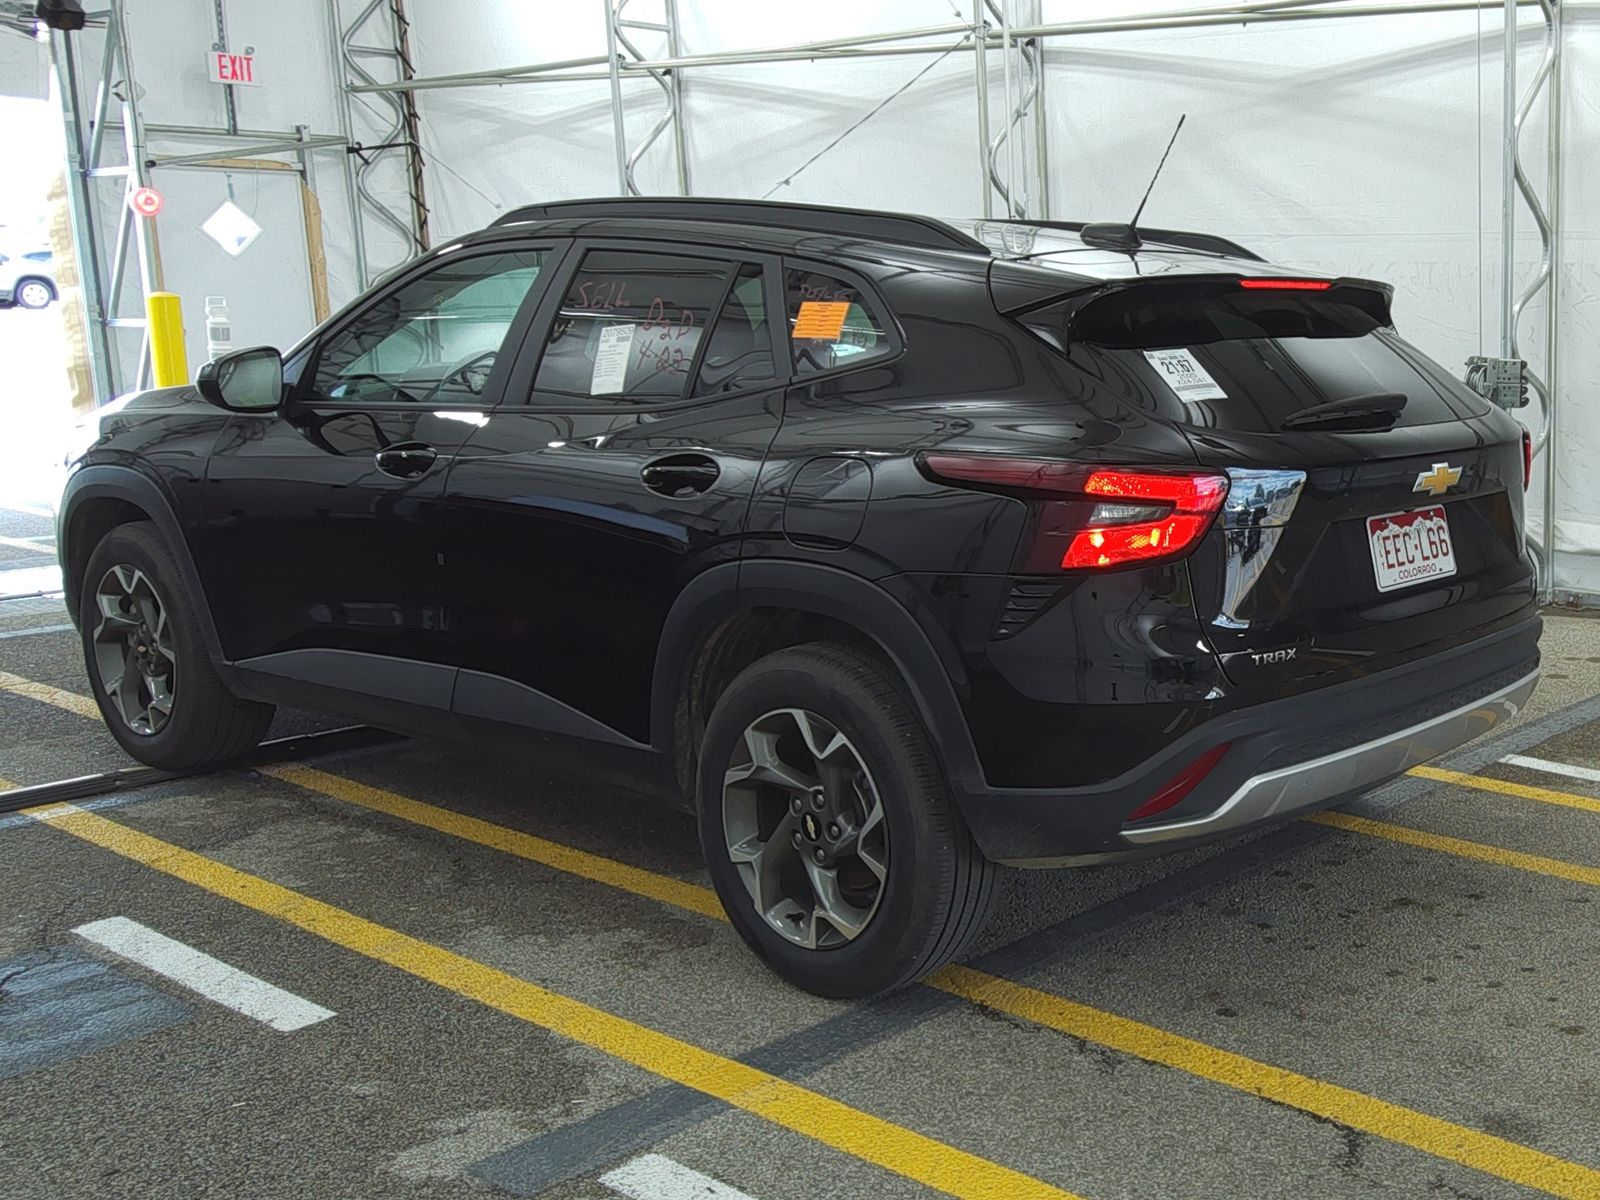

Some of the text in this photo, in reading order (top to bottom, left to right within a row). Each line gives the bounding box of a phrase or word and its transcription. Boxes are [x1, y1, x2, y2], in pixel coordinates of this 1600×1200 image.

[217, 53, 252, 82] EXIT
[1398, 563, 1437, 580] COLORADO
[1251, 648, 1296, 666] TRAX
